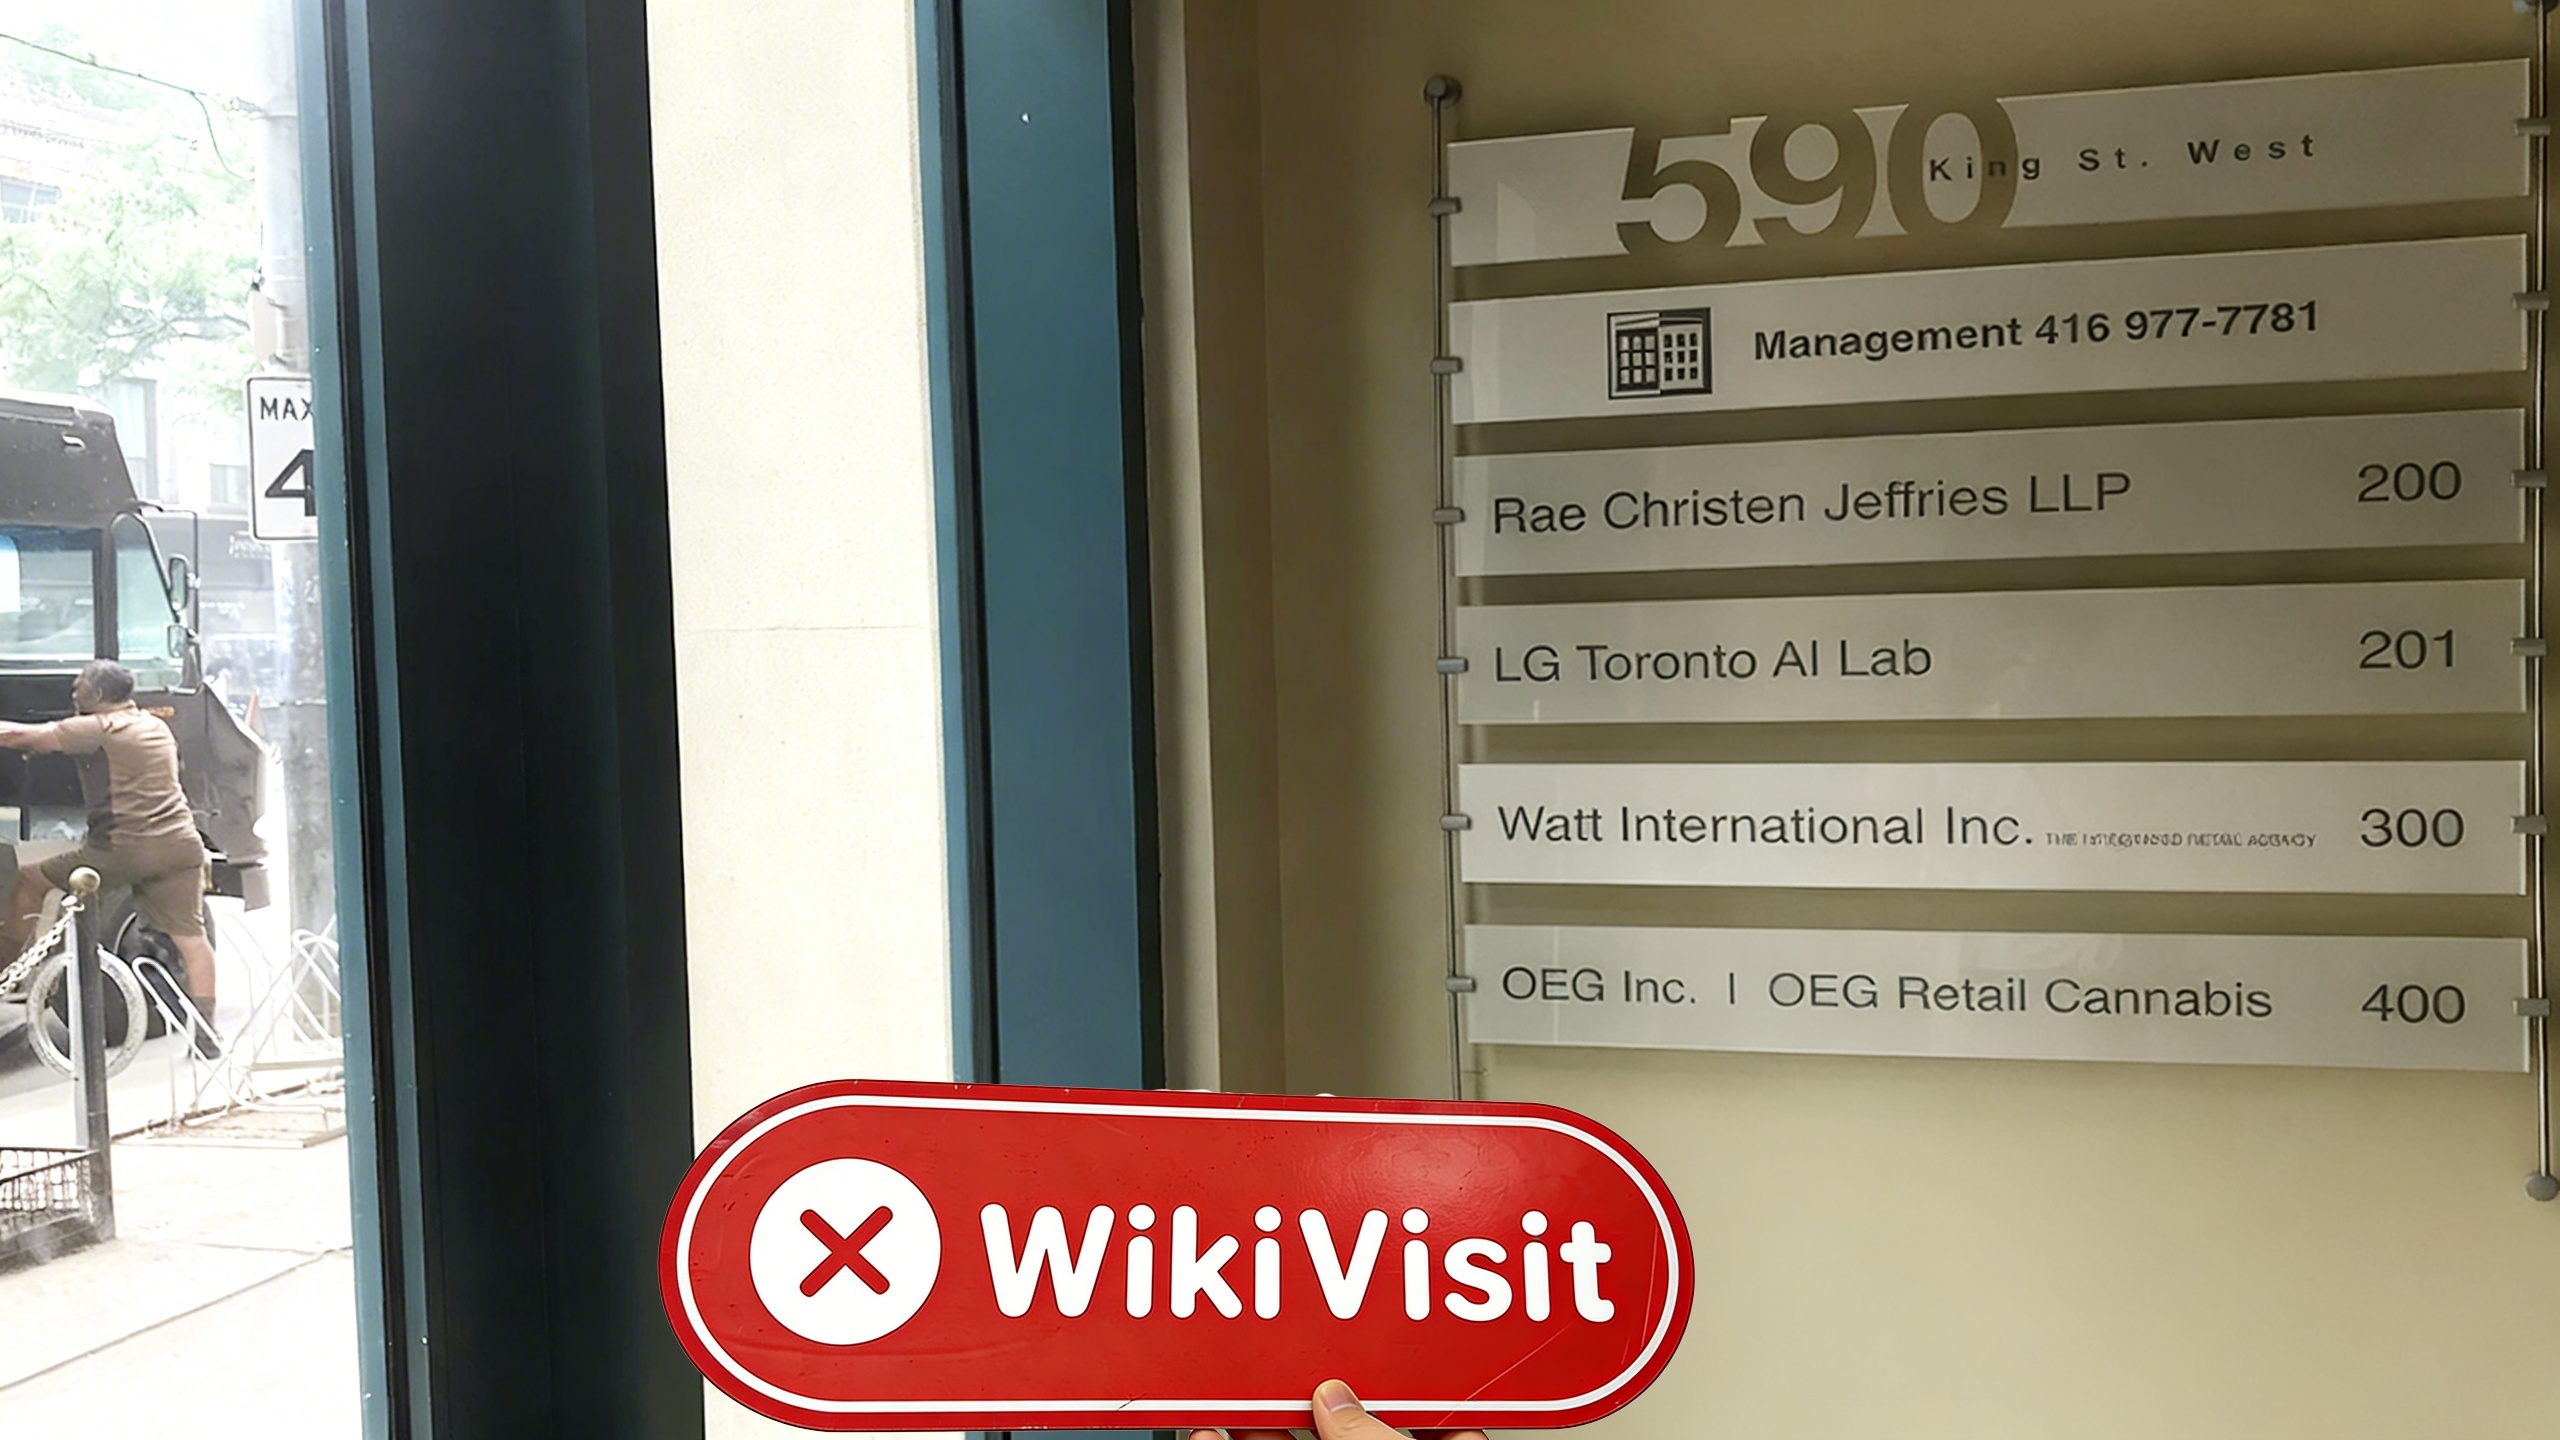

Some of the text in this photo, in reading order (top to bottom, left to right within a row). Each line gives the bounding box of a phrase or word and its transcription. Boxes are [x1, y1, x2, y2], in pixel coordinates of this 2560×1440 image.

[1616, 97, 2018, 255] 590
[1929, 133, 2315, 181] King St. West
[1754, 300, 2317, 364] Management 416 977-7781
[260, 396, 314, 421] MAX
[1493, 471, 2132, 535] Rae Christen Jeffries LLP
[2357, 460, 2463, 503] 200
[1495, 637, 1932, 683] LG Toronto AI Lab
[2358, 628, 2456, 670] 201
[1497, 804, 2034, 846] Watt International Inc.
[2360, 808, 2465, 848] 300
[1501, 965, 1605, 1003] OEG
[1623, 969, 1697, 1005] Inc.
[1768, 971, 1879, 1009] OEG
[1897, 975, 2027, 1013] Retail
[2044, 978, 2273, 1019] Cannabis
[2360, 983, 2467, 1024] 400
[979, 1202, 1616, 1324] WikiVisit
